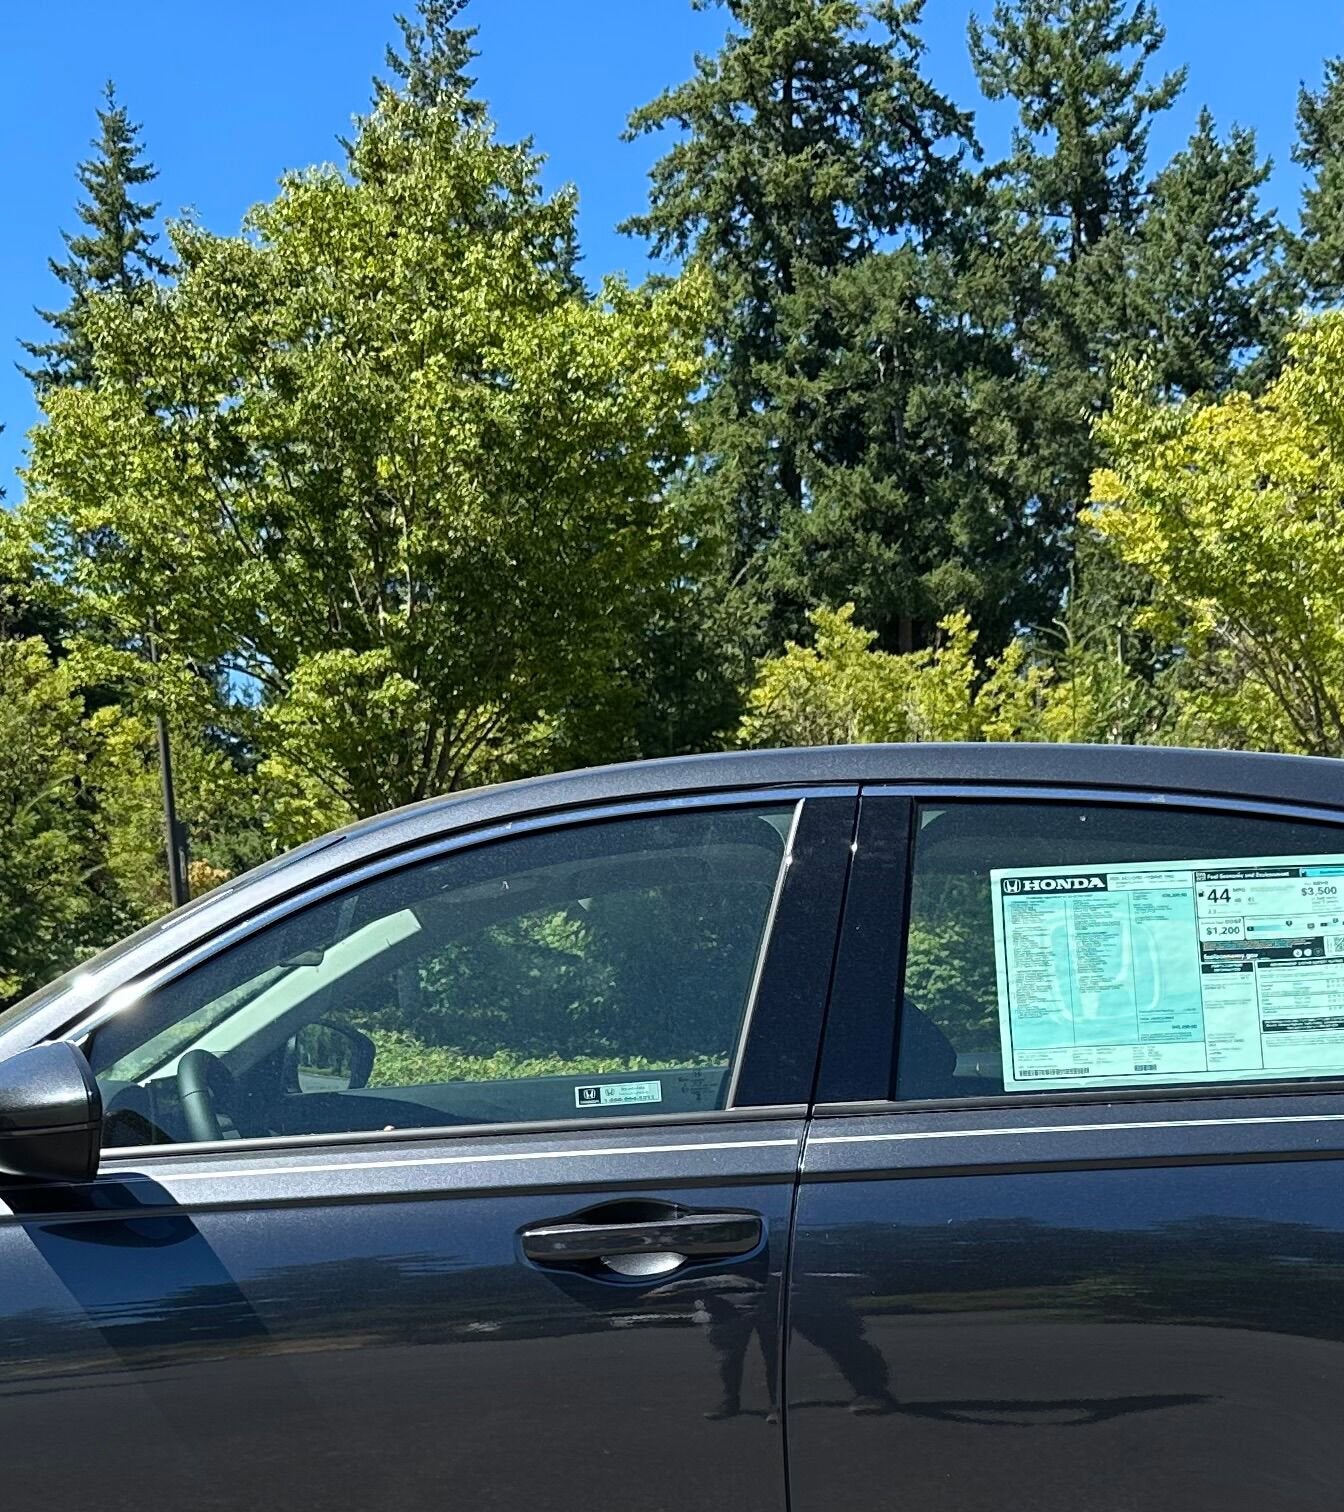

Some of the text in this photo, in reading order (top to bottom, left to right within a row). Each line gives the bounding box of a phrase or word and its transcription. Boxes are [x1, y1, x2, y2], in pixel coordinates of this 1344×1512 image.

[1023, 877, 1105, 891] HONDA
[1207, 888, 1231, 903] 44
[1301, 886, 1337, 896] $3,500
[1206, 926, 1240, 936] $1,200
